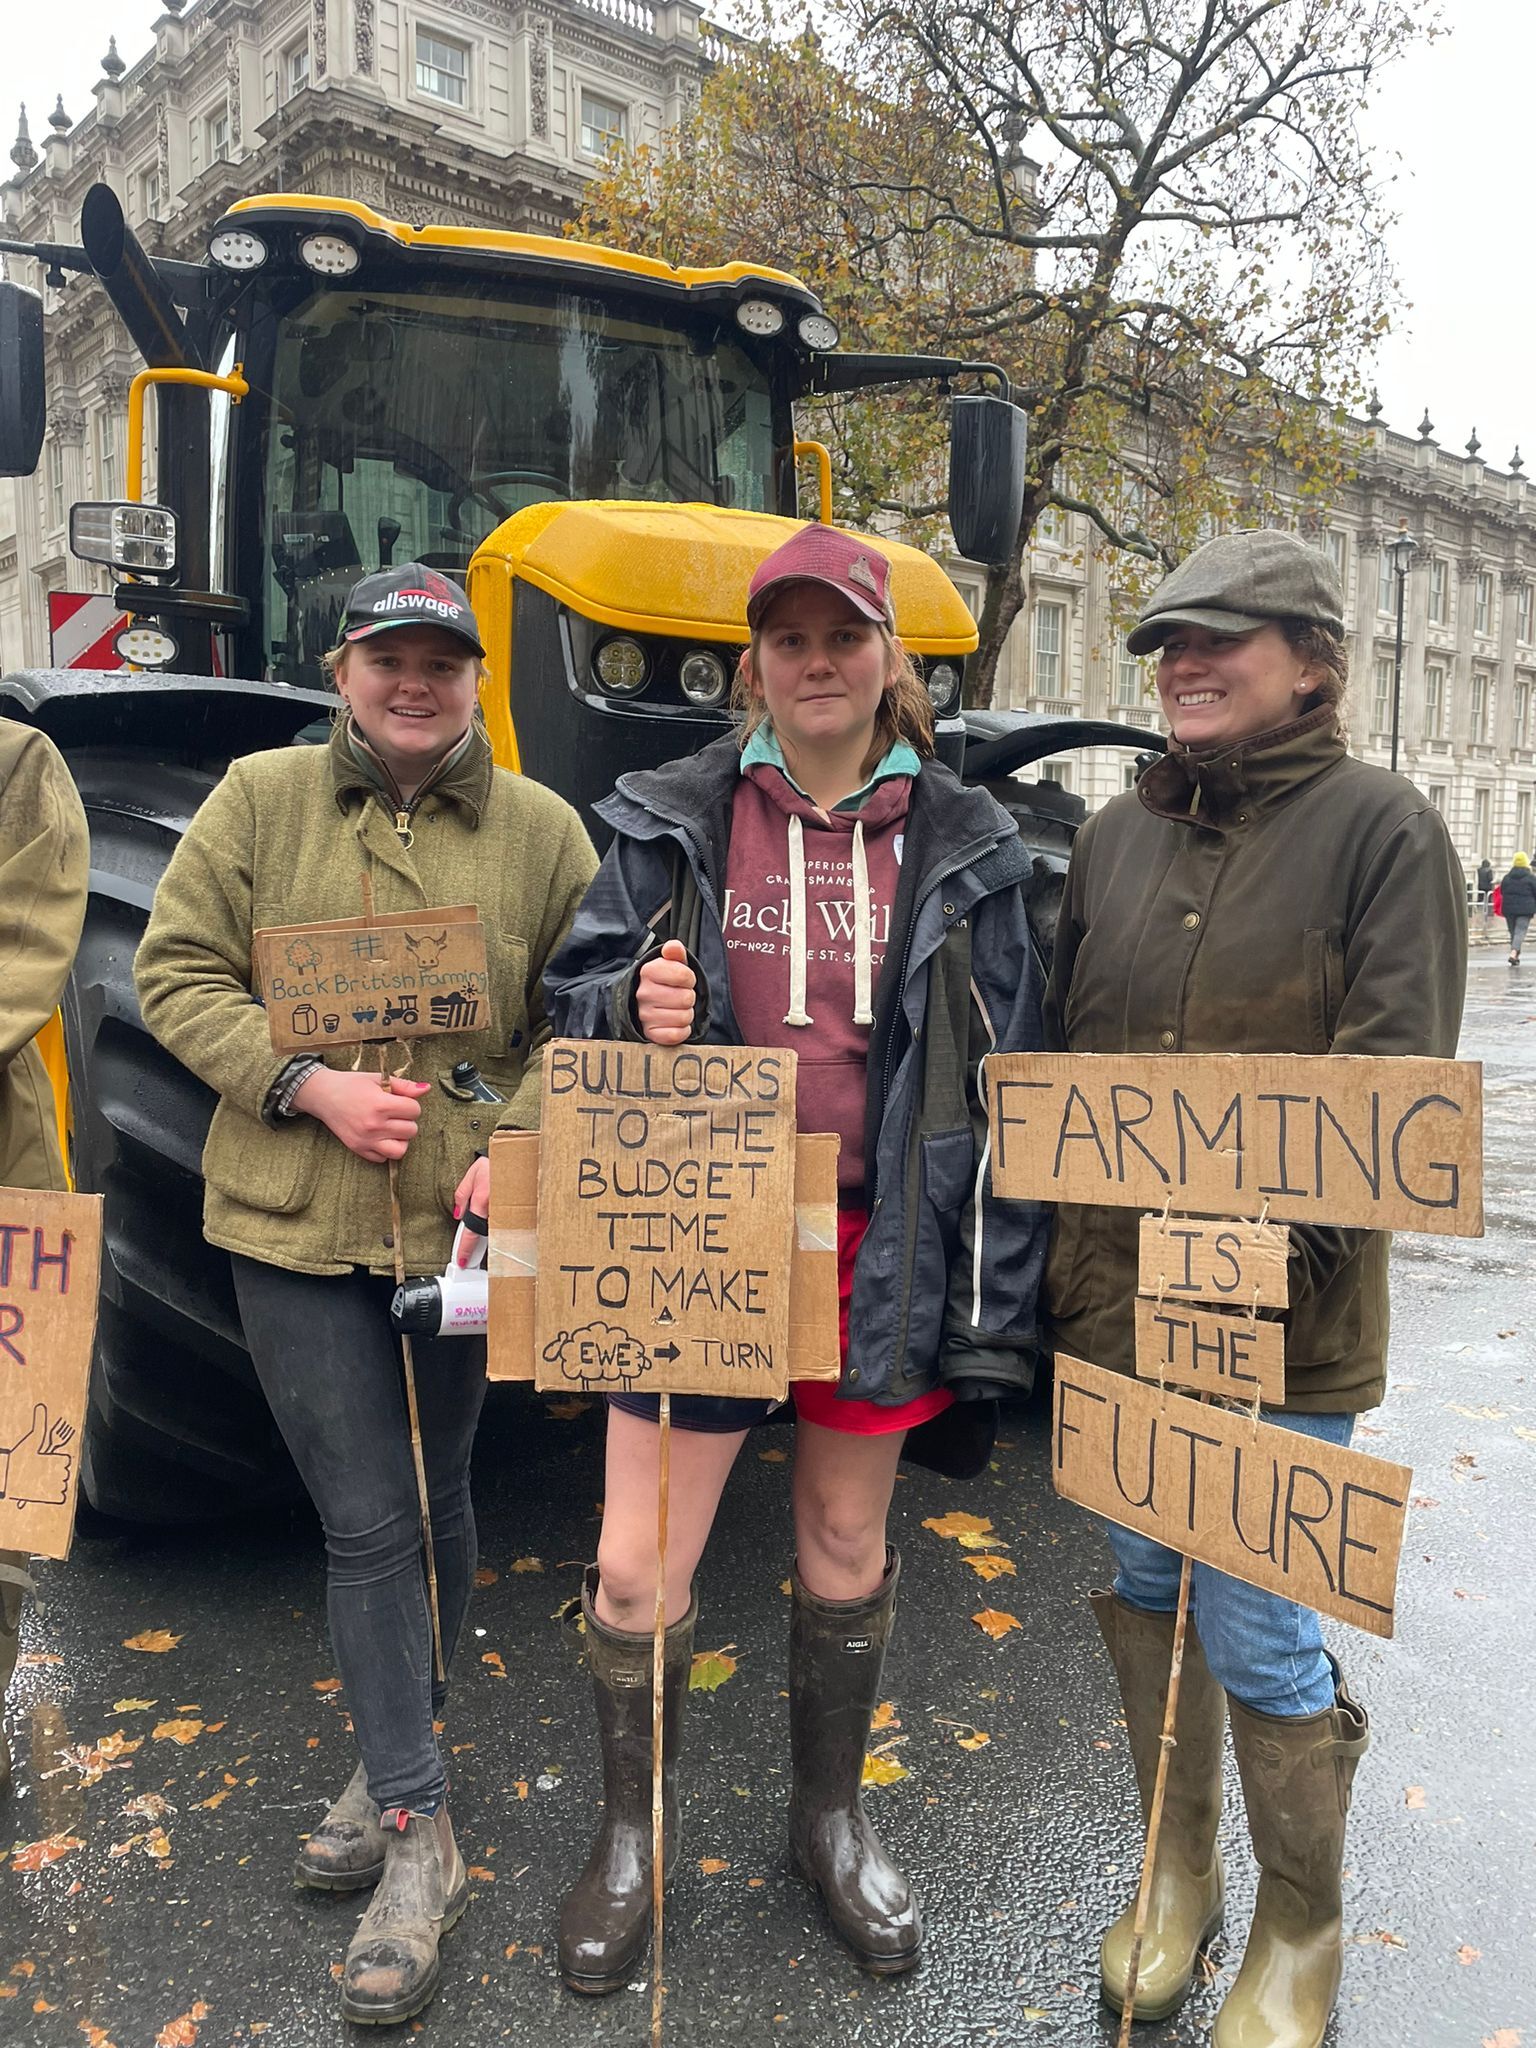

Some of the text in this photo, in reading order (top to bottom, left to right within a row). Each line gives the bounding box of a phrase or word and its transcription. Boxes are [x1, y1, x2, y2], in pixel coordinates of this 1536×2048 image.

[373, 591, 459, 619] allswage
[271, 969, 488, 1000] Back British Farming
[551, 1048, 781, 1100] BULLOCKS
[576, 1107, 776, 1152] TO THE
[996, 1080, 1462, 1209] FARMING
[578, 1158, 767, 1199] BUDGET
[597, 1212, 729, 1253] TIME
[1168, 1230, 1242, 1293] IS
[560, 1265, 769, 1314] TO MAKE
[580, 1339, 773, 1369] EWE TURN
[1154, 1315, 1258, 1383] THE
[1057, 1379, 1404, 1614] FUTURE
